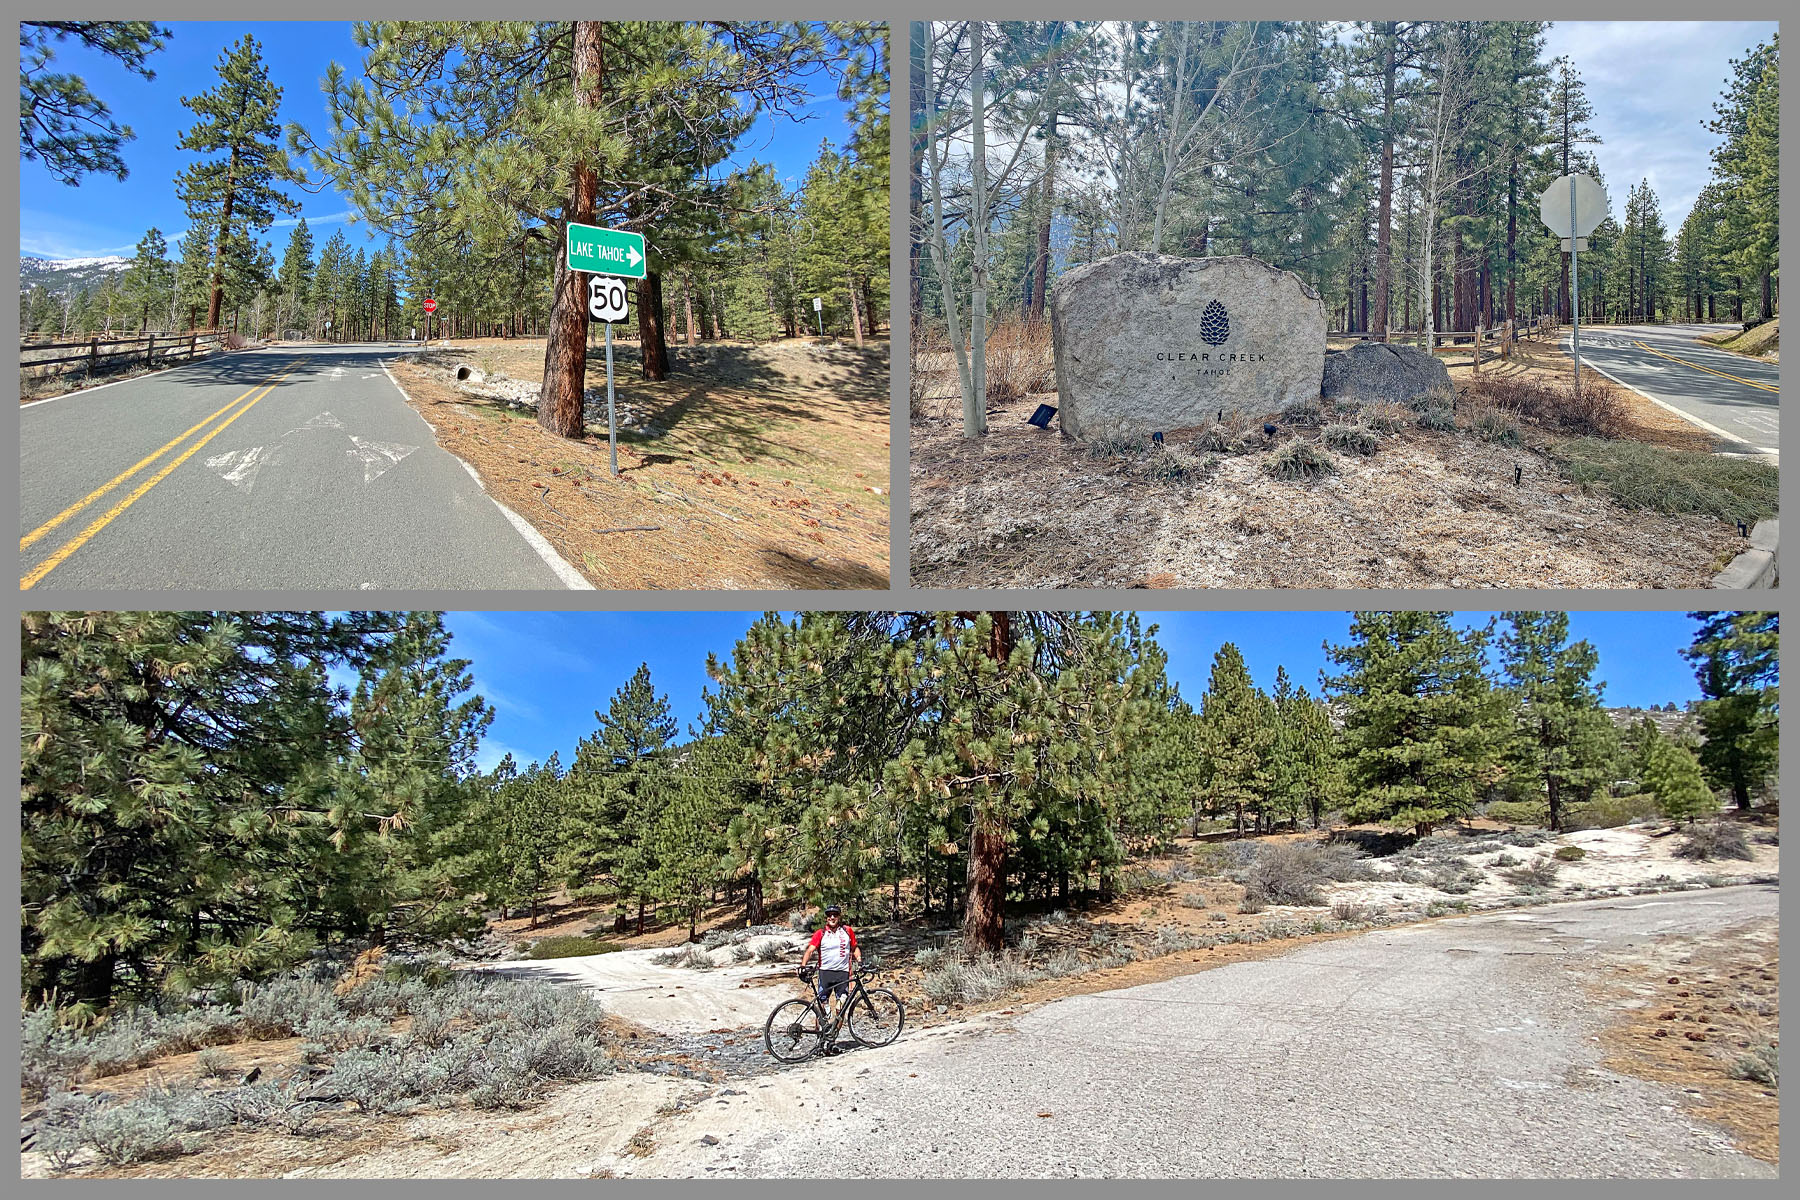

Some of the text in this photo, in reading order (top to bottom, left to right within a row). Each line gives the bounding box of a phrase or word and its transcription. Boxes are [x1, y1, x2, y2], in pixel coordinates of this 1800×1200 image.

[570, 240, 625, 262] LAKE TAHOE
[594, 284, 624, 311] 50
[1156, 352, 1266, 362] CLEAR CREEK
